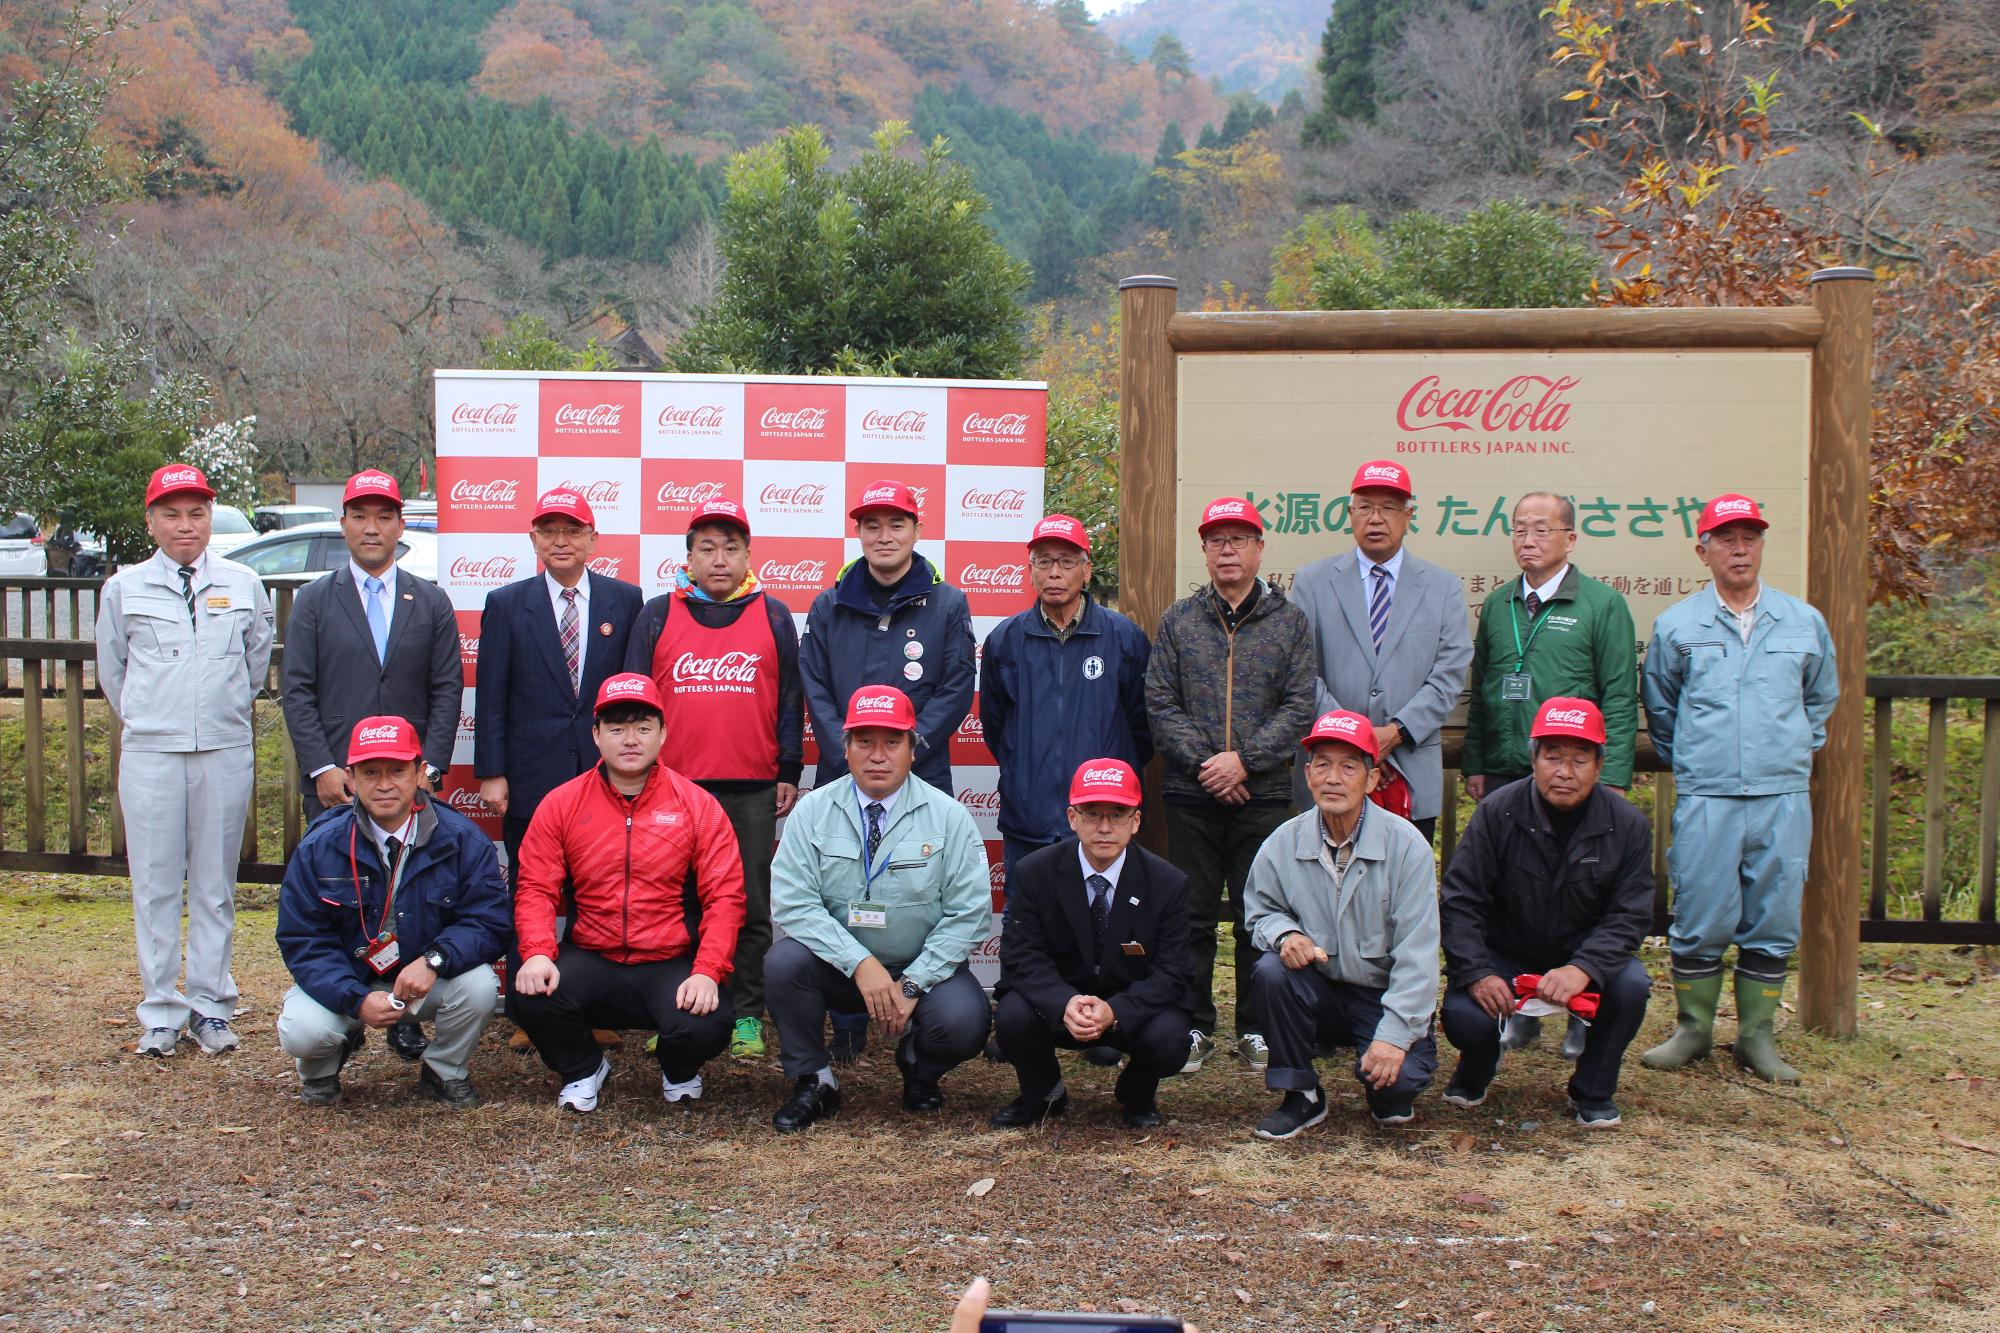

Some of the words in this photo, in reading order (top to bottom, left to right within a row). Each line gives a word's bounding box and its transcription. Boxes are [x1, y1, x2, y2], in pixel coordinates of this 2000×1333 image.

[1396, 375, 1584, 432] Coca-Cola
[452, 403, 520, 424] Coca-Cola
[555, 403, 624, 426] Coca-Cola
[659, 405, 726, 427] Coca-Cola
[760, 407, 830, 430] Coca-Cola
[862, 410, 928, 432] Coca-Cola
[962, 412, 1030, 434] Coca-Cola
[1396, 441, 1481, 454] BOTTLERS
[1486, 441, 1537, 455] JAPAN
[1542, 441, 1575, 454] INC.
[162, 470, 197, 484] Coca-Cola
[356, 476, 391, 486] Coca-Cola
[1364, 466, 1401, 480] Coca-Cola
[450, 480, 520, 502] Coca-Cola
[760, 484, 828, 506] Coca-Cola
[863, 486, 898, 502] Coca-Cola
[962, 488, 1028, 510] Coca-Cola
[542, 494, 578, 506] Coca-Cola
[704, 501, 739, 512] Coca-Cola
[1715, 499, 1752, 512] Coca-Cola
[1208, 502, 1246, 516] Coca-Cola
[1039, 520, 1075, 532] Coca-Cola
[450, 556, 518, 578] Coca-Cola
[759, 560, 828, 582] Coca-Cola
[960, 564, 1026, 586] Coca-Cola
[672, 652, 762, 682] Coca-Cola
[606, 678, 647, 694] Coca-Cola
[674, 684, 713, 694] BOTTLERS
[715, 685, 742, 693] JAPAN
[856, 696, 896, 710] Coca-Cola
[1319, 716, 1360, 730] Coca-Cola
[1546, 708, 1588, 724] Coca-Cola
[360, 724, 400, 741] Coca-Cola
[1083, 768, 1126, 782] Coca-Cola
